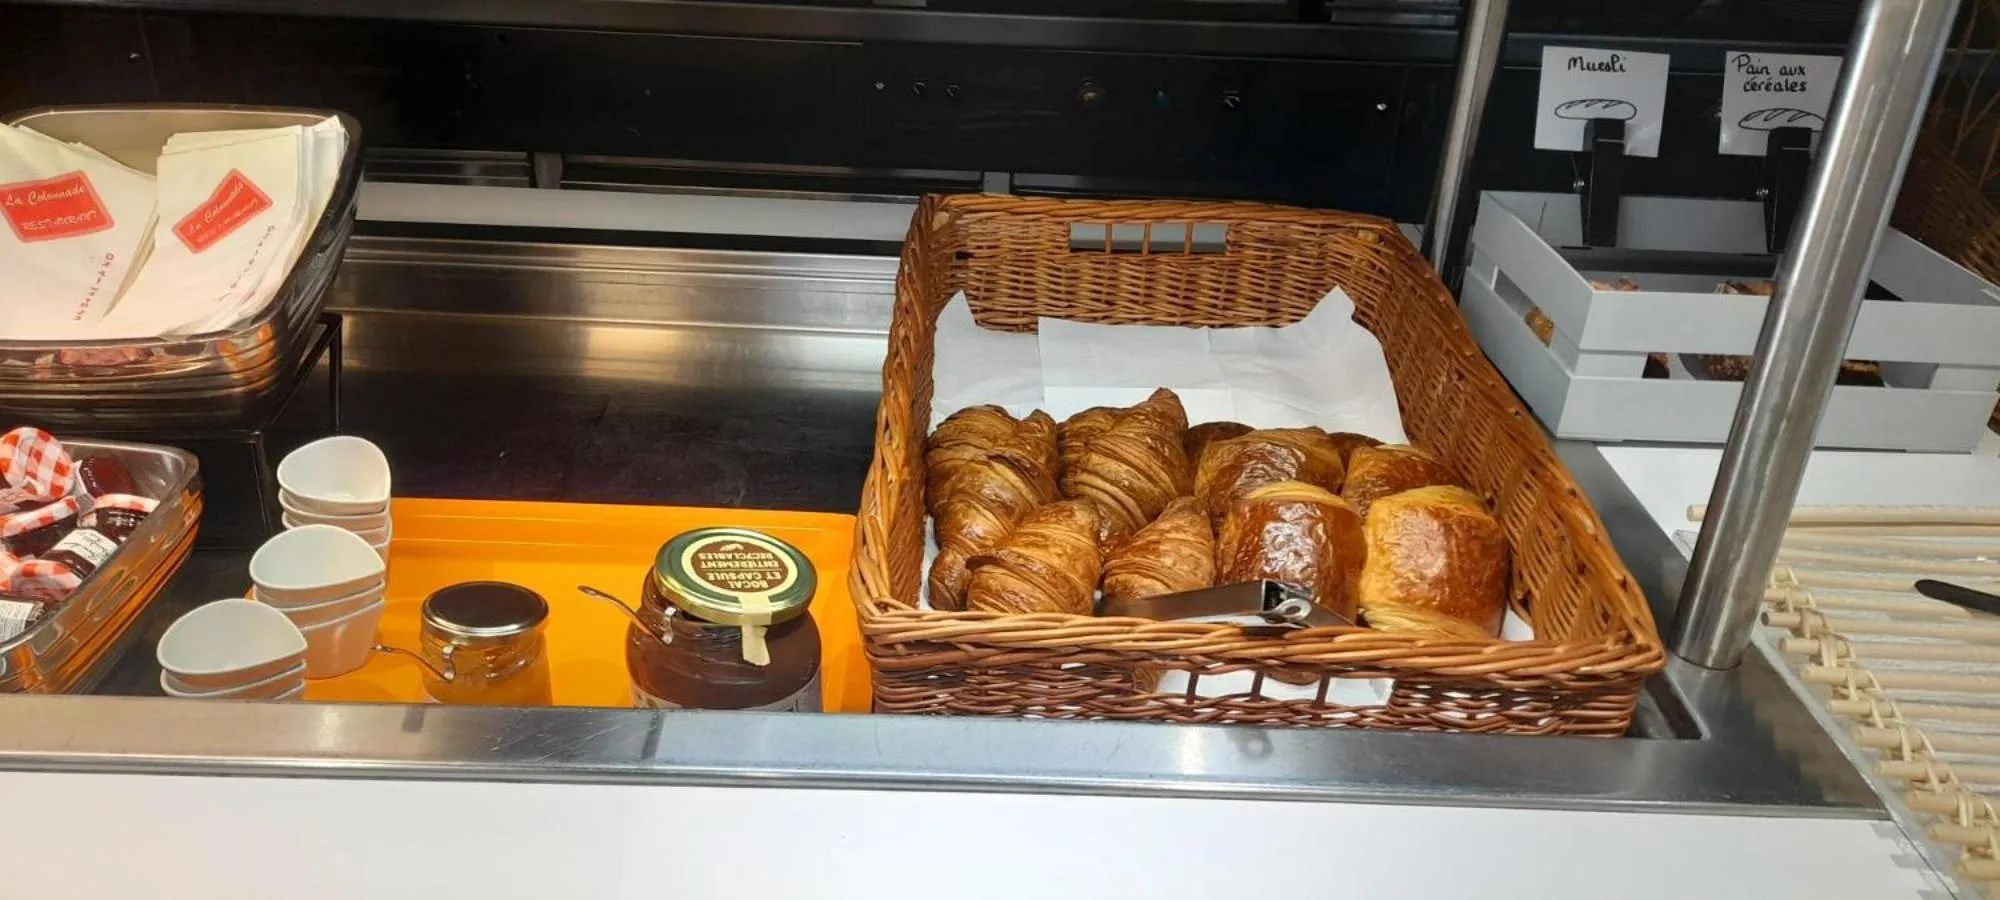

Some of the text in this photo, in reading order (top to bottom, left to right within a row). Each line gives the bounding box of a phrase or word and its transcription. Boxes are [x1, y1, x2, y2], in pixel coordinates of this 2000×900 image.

[1568, 54, 1627, 73] Muesli
[1732, 54, 1806, 76] Pain aux
[1743, 76, 1807, 92] céréales
[5, 193, 23, 205] La
[698, 552, 773, 560] RECYCLABLES
[706, 571, 782, 581] ET CAPSULE
[728, 580, 769, 589] BOCAL
